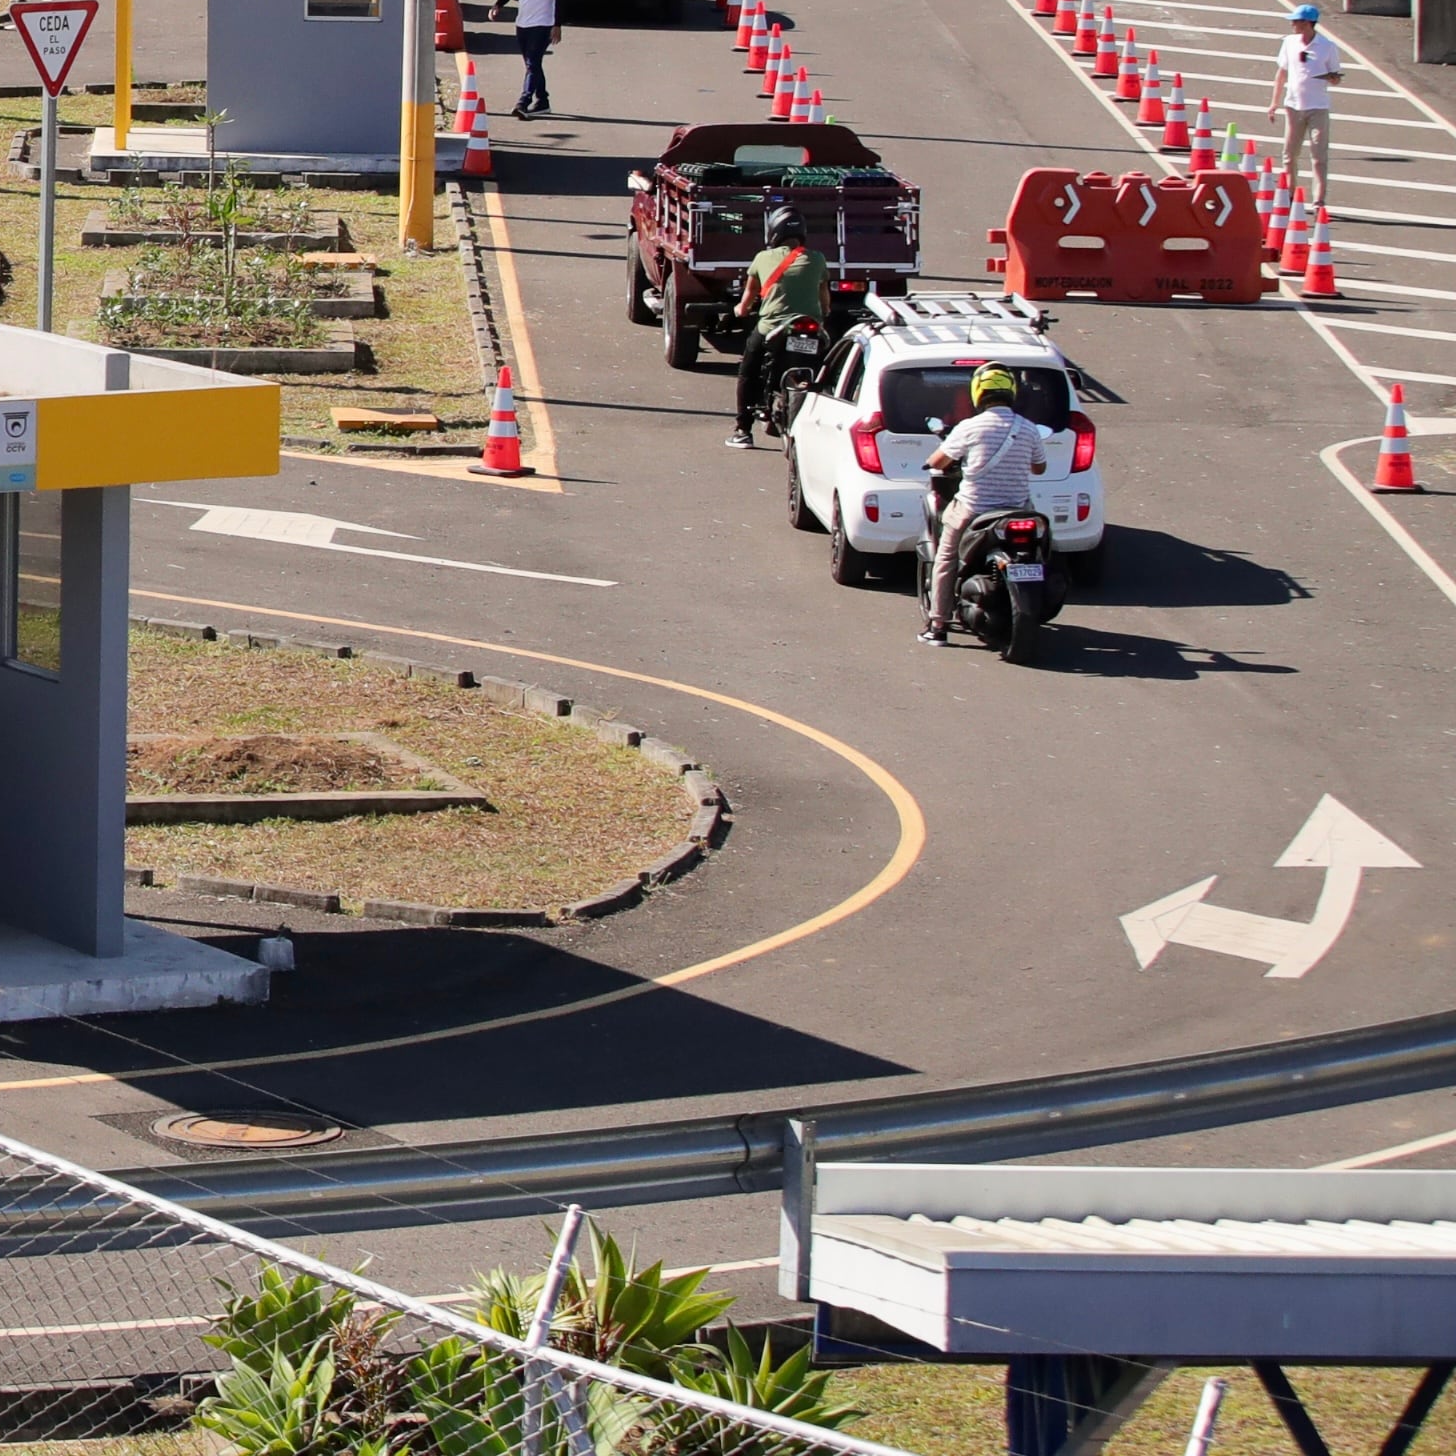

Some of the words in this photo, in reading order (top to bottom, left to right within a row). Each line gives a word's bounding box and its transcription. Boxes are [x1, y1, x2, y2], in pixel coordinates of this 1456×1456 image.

[39, 15, 70, 32] CEDA
[49, 34, 60, 44] EL
[43, 46, 66, 55] PASO
[1155, 278, 1189, 290] VIAL
[1200, 278, 1234, 290] 2022
[6, 445, 27, 453] CCTV
